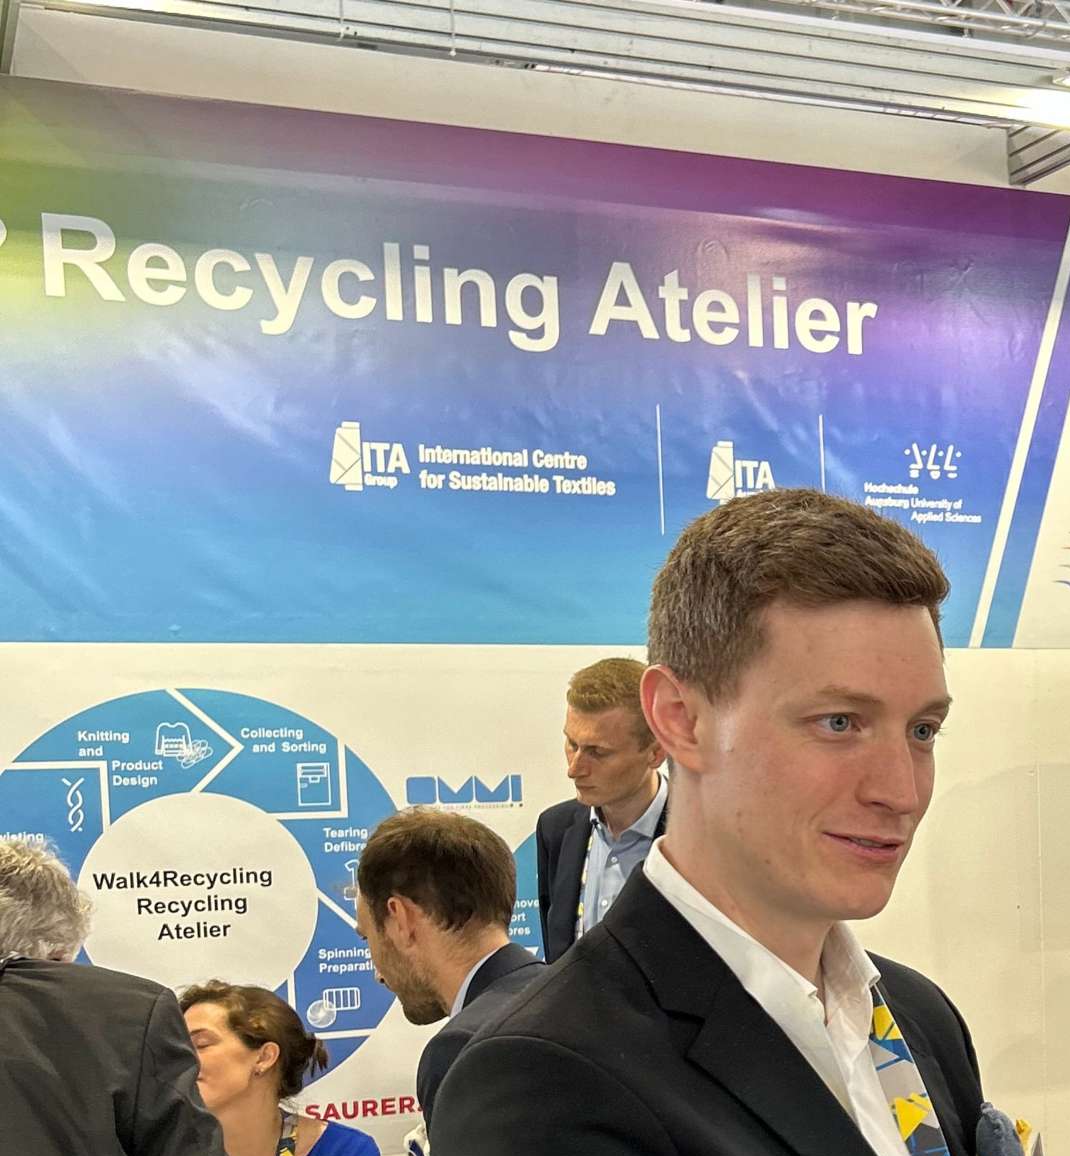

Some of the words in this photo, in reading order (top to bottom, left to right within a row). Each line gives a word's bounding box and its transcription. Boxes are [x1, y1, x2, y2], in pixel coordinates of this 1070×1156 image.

[41, 211, 560, 351] Recycling
[588, 261, 878, 355] Atelier
[362, 441, 410, 474] ITA
[419, 444, 529, 468] International
[532, 449, 587, 470] Centre
[364, 473, 398, 489] Group
[419, 470, 445, 489] for
[448, 471, 549, 494] Sustainable
[552, 475, 616, 496] Textiles
[952, 500, 963, 510] of
[911, 511, 943, 524] Applied
[945, 512, 982, 524] Sciences
[78, 730, 130, 743] Knitting
[240, 727, 304, 740] Collecting
[79, 746, 103, 757] and
[252, 742, 276, 753] and
[282, 742, 327, 755] Sorting
[112, 760, 163, 771] Product
[113, 775, 158, 787] Design
[323, 826, 368, 840] Tearing
[93, 868, 273, 891] Walk4Recycling
[137, 895, 248, 917] Recycling
[157, 921, 231, 941] Atelier
[318, 946, 372, 961] Spinning
[319, 961, 376, 975] Preparati
